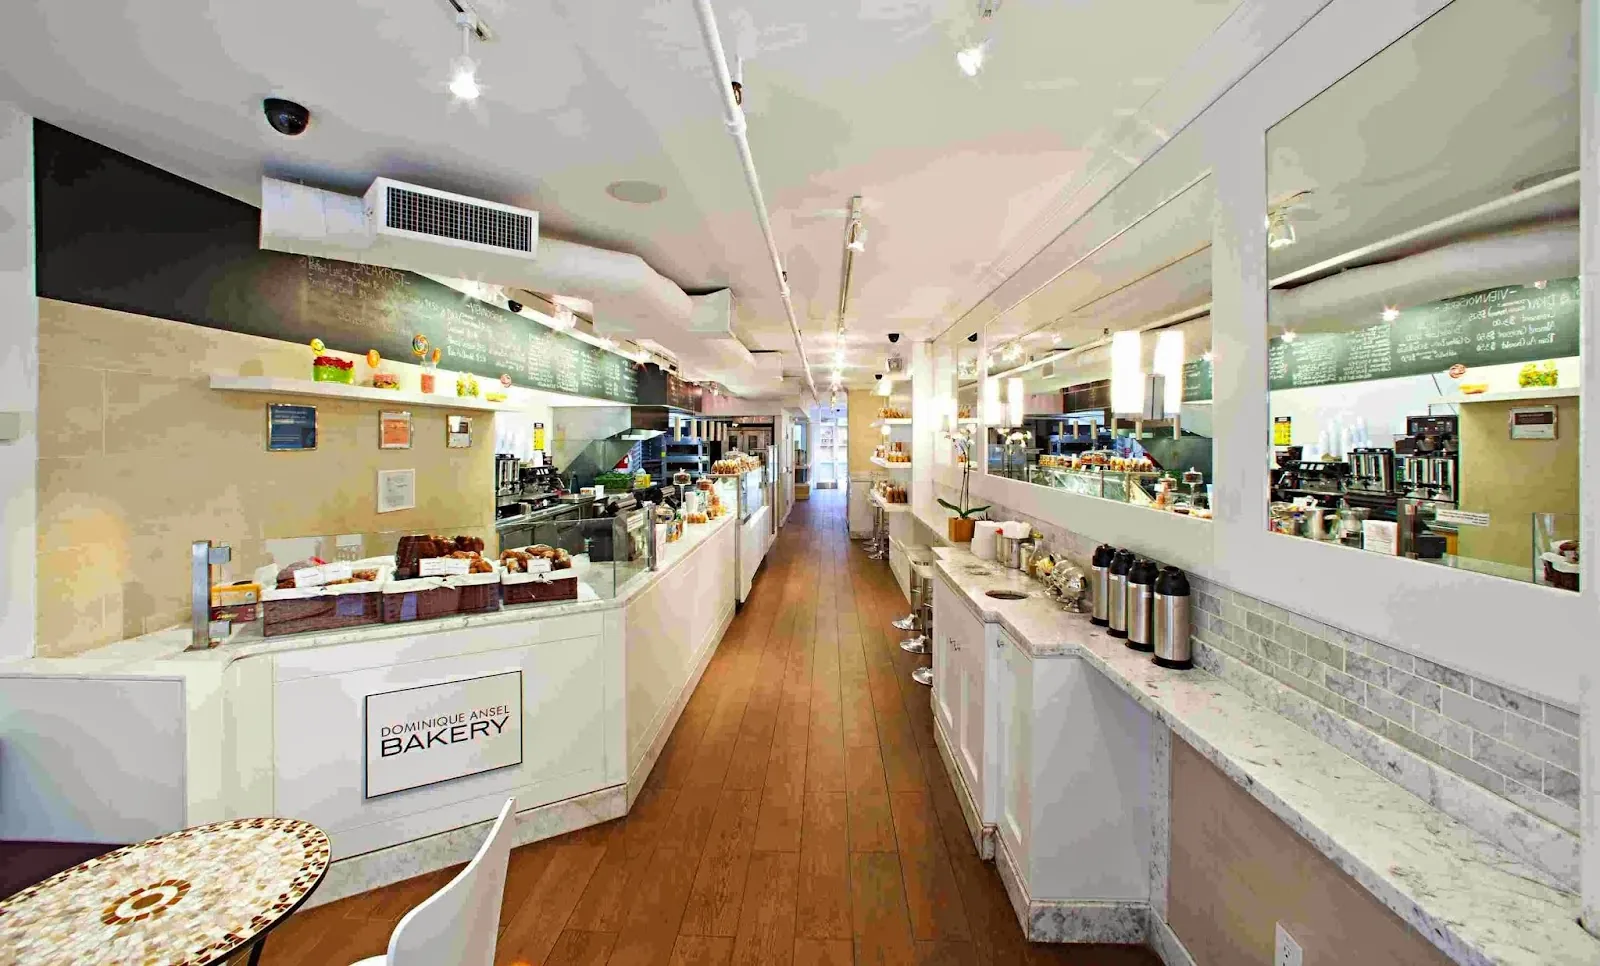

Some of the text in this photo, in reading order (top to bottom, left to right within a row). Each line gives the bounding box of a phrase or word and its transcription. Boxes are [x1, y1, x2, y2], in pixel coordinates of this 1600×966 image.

[381, 705, 510, 738] DOMINIQUE ANSEL
[381, 716, 509, 758] BAKERY
